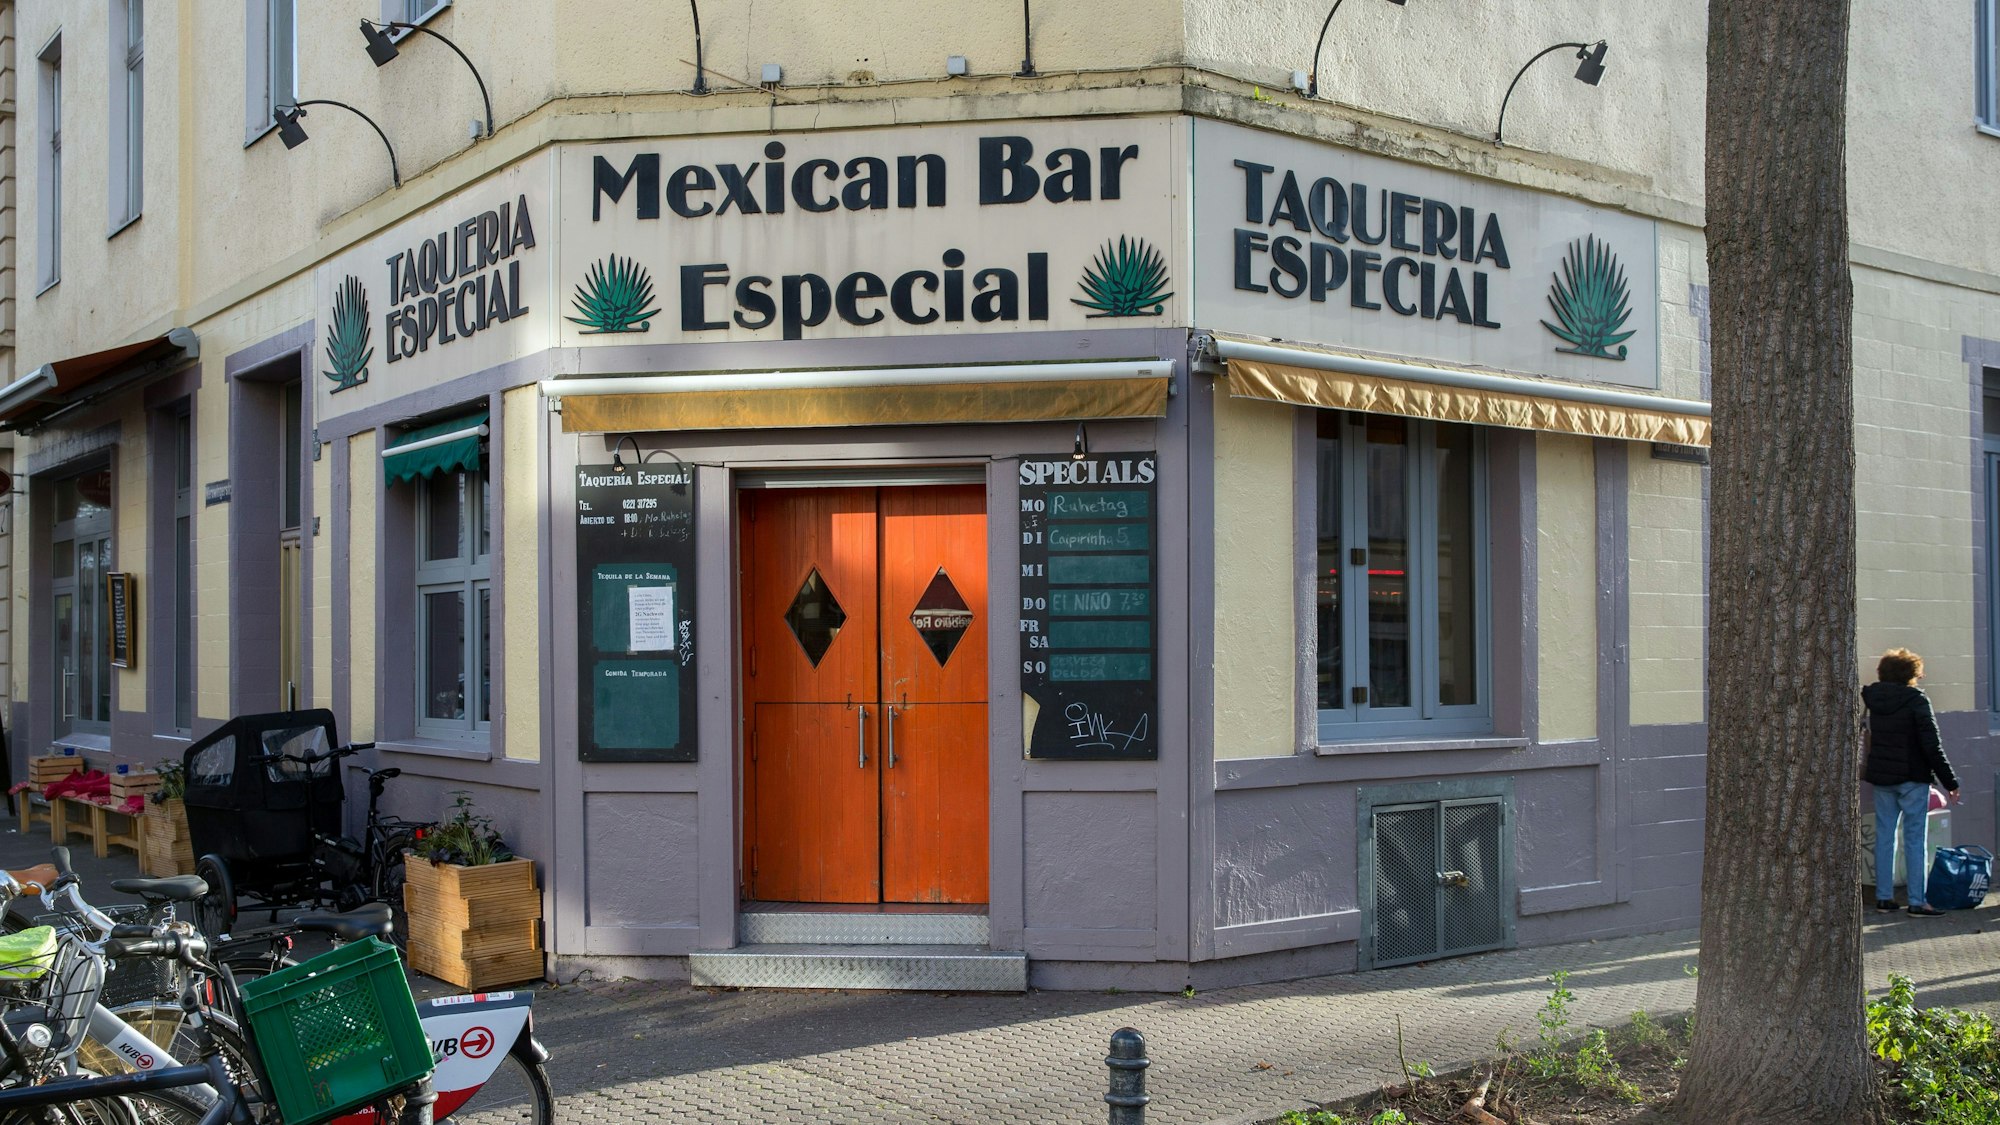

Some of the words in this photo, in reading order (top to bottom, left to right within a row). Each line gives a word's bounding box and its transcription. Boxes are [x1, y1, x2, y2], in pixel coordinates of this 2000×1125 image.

[592, 141, 946, 222] Mexican
[979, 136, 1139, 204] Bar
[1233, 158, 1511, 269] TAQUERIA
[386, 194, 536, 306] TAQUERIA
[1234, 228, 1501, 329] ESPECIAL
[680, 248, 1048, 340] Especial
[386, 260, 529, 364] ESPECIAL
[637, 471, 690, 485] ESPECIAL
[1019, 459, 1155, 486] SPECIALS
[622, 499, 636, 509] 0221
[1021, 499, 1045, 512] MO
[1053, 494, 1128, 518] Ruhetag
[606, 516, 615, 525] DE
[1023, 531, 1043, 545] DI
[597, 572, 623, 580] TEQUILA
[646, 572, 671, 580] SEMANA
[1021, 564, 1044, 577] MI
[1023, 597, 1046, 610] DO
[1020, 620, 1040, 632] FR
[1029, 636, 1049, 649] SA
[605, 669, 628, 677] COMIDA
[631, 669, 667, 677] TEMPORADA
[1023, 661, 1046, 674] SO
[118, 1042, 141, 1059] KVB
[432, 1038, 458, 1056] VB
